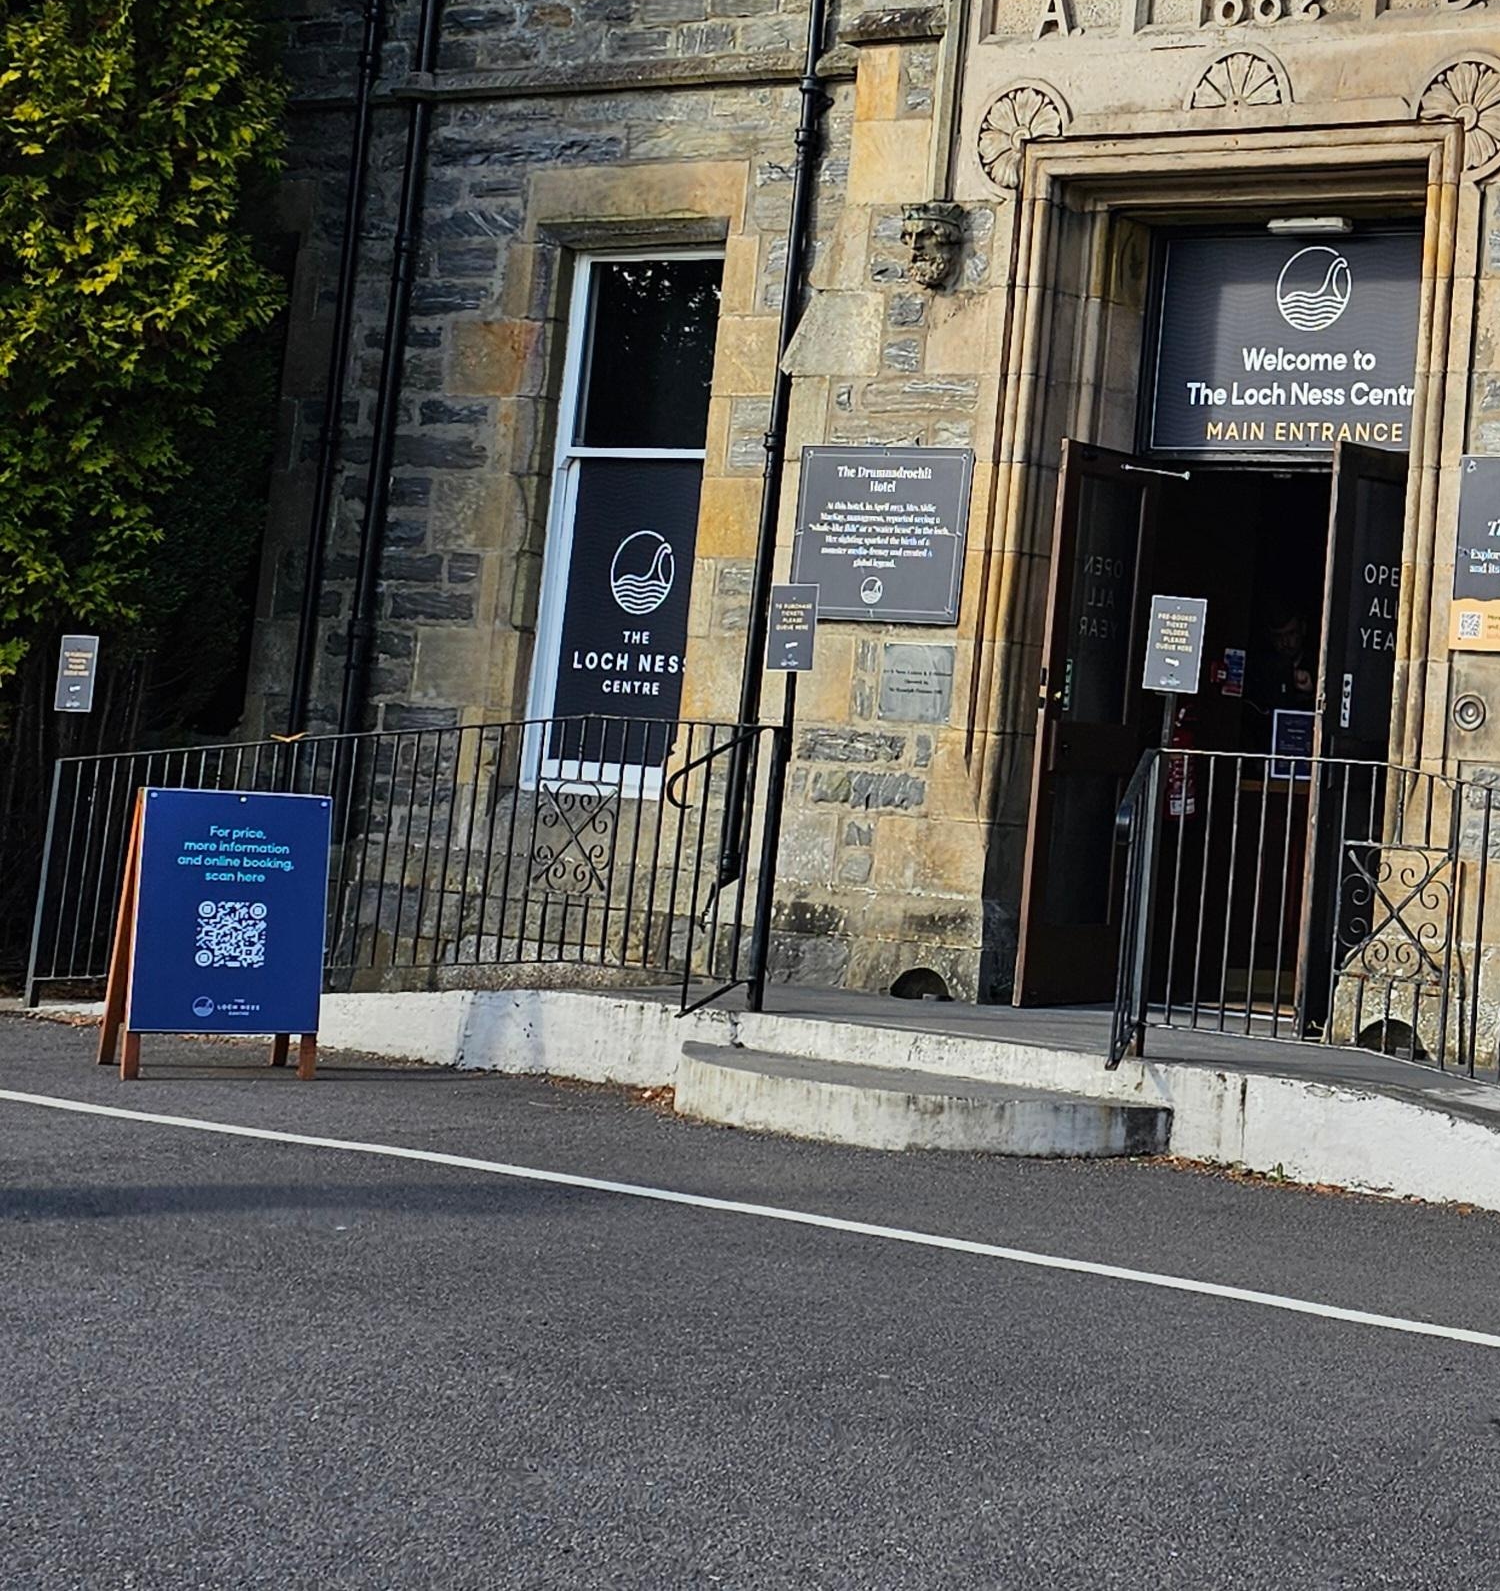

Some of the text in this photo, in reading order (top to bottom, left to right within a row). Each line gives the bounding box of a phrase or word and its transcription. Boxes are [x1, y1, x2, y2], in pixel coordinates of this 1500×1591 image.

[1242, 347, 1376, 371] Welcome to
[1187, 382, 1415, 406] The Loch Ness Centr
[1206, 422, 1403, 442] MAIN ENTRANCE
[838, 466, 856, 478] The
[870, 481, 896, 492] Hotel
[1364, 563, 1400, 587] OPE
[1469, 563, 1487, 573] and
[1488, 564, 1500, 574] its
[622, 631, 650, 645] THE
[1163, 636, 1186, 644] PLEASE
[1360, 627, 1396, 652] YEA
[1155, 643, 1193, 653] QUEUE HERE
[572, 651, 628, 671] LOCH
[602, 679, 660, 695] CENTRE
[1342, 680, 1351, 722] PULL
[210, 826, 231, 837] For
[184, 841, 290, 854] more information
[178, 855, 294, 872] and online booking,
[205, 871, 265, 882] scan here
